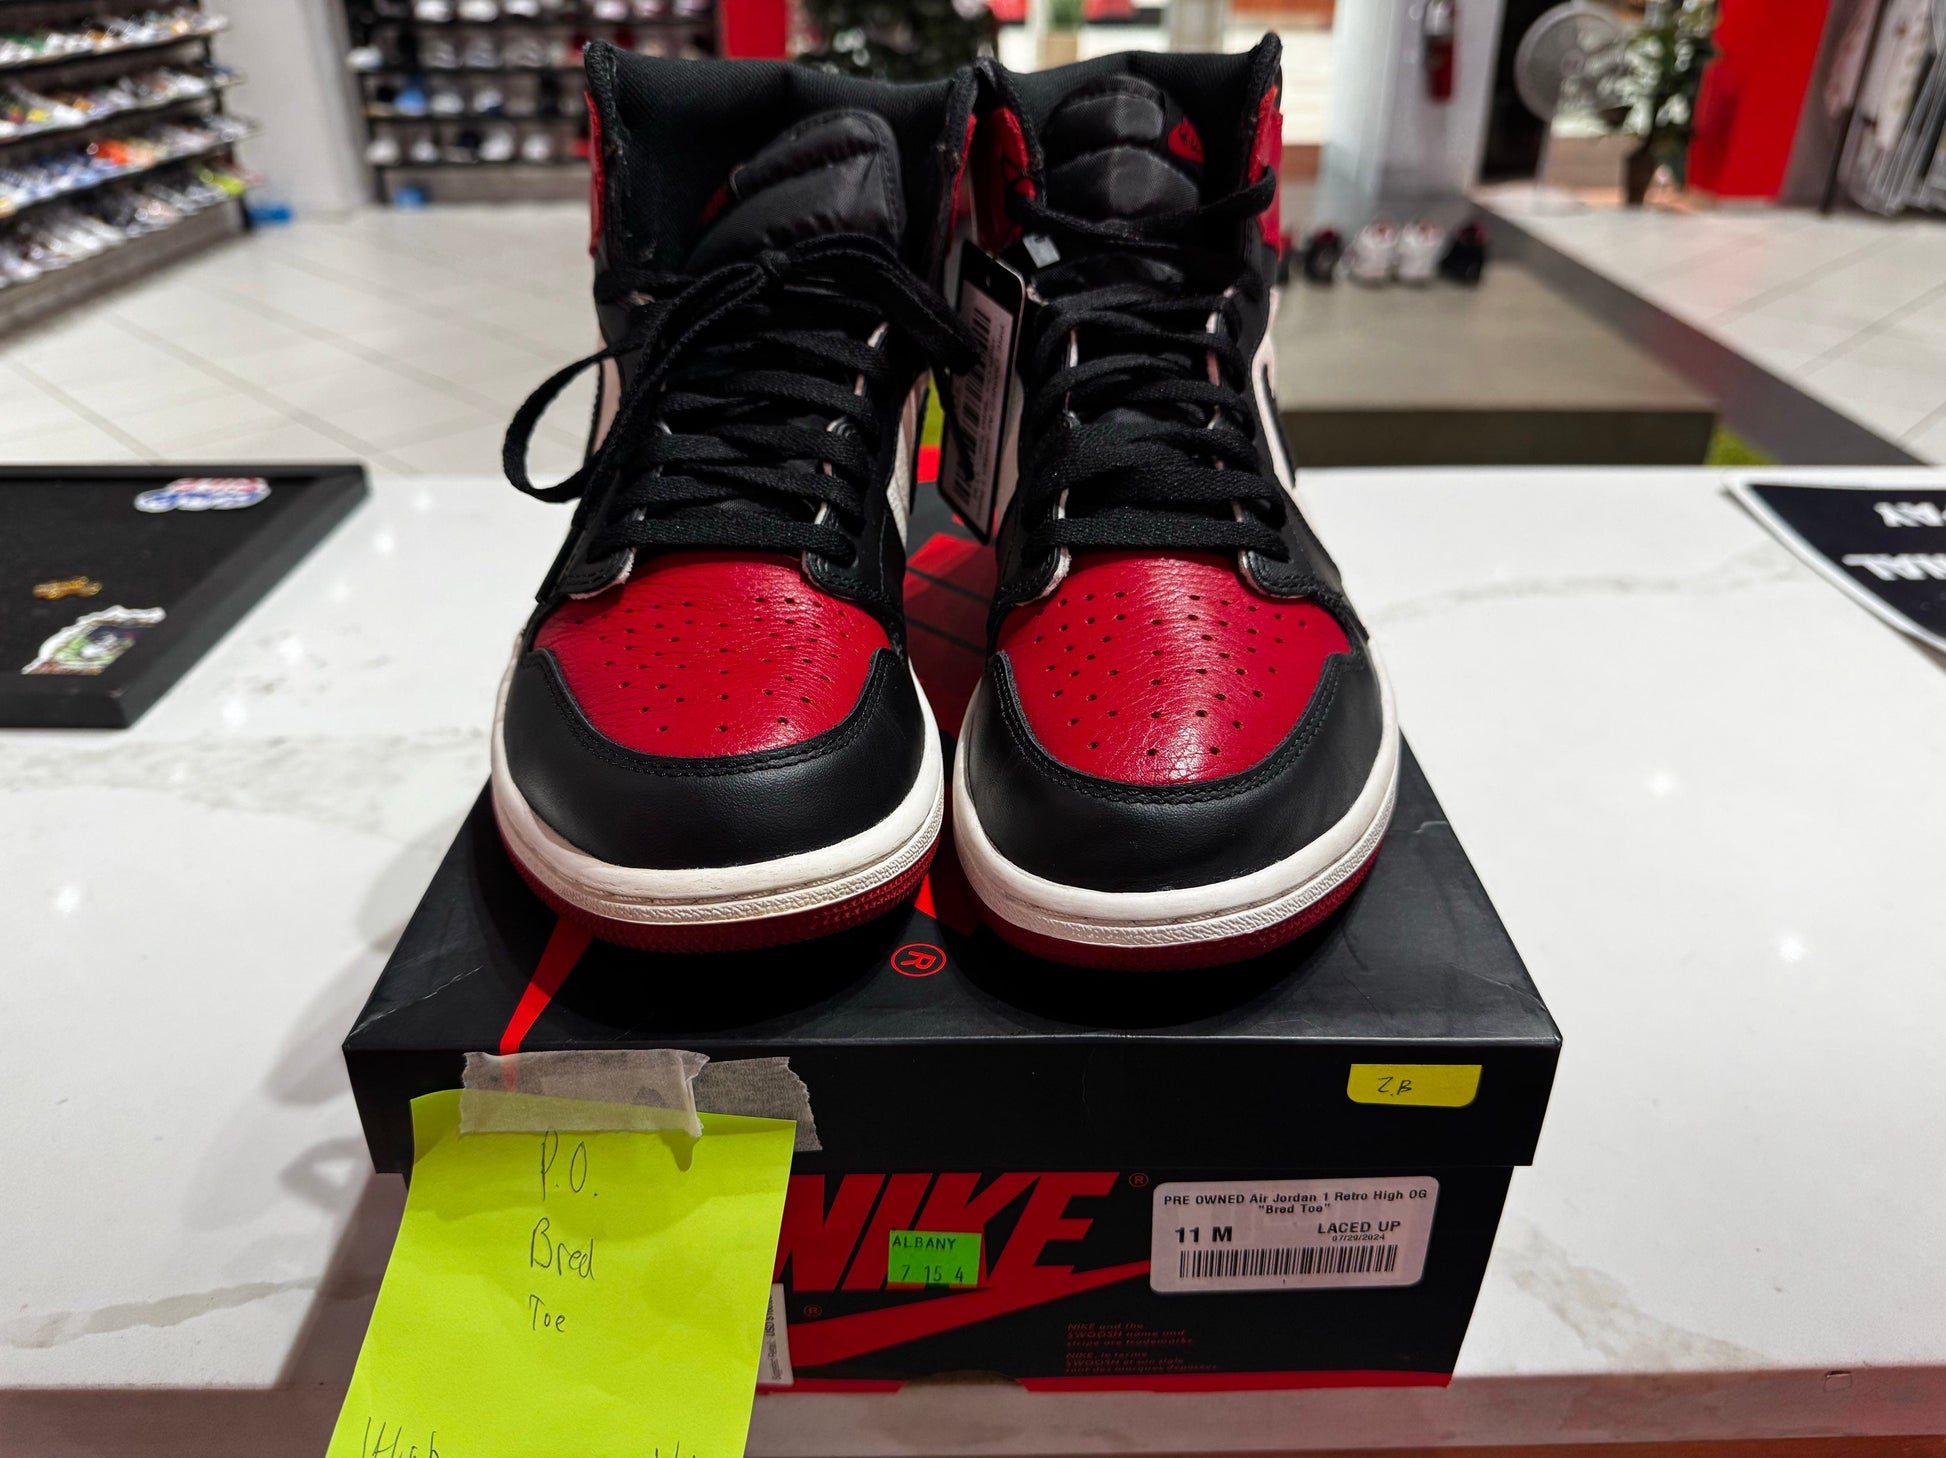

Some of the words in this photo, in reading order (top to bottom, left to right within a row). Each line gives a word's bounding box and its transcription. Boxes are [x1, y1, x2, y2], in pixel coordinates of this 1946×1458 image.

[1163, 1194, 1190, 1206] PRE
[1195, 1193, 1245, 1205] OWNED
[1249, 1192, 1269, 1204] Air
[1272, 1192, 1317, 1203] Jordan
[1322, 1192, 1330, 1201] 1
[1334, 1191, 1368, 1202] Retro
[1373, 1189, 1404, 1202] High
[1408, 1188, 1428, 1199] OG
[771, 1171, 1120, 1292] NIKE
[1174, 1226, 1200, 1243] 11
[1211, 1225, 1233, 1242] M
[1317, 1221, 1371, 1234] LACED
[1377, 1220, 1401, 1232] UP
[892, 1235, 957, 1250] ALBANY
[1331, 1233, 1385, 1242] 07/29/2024
[530, 1216, 595, 1280] Bred
[902, 1264, 911, 1281] 7
[924, 1265, 943, 1282] 15
[955, 1266, 963, 1282] 4
[529, 1294, 566, 1333] Toe
[1067, 1322, 1096, 1331] NIKE
